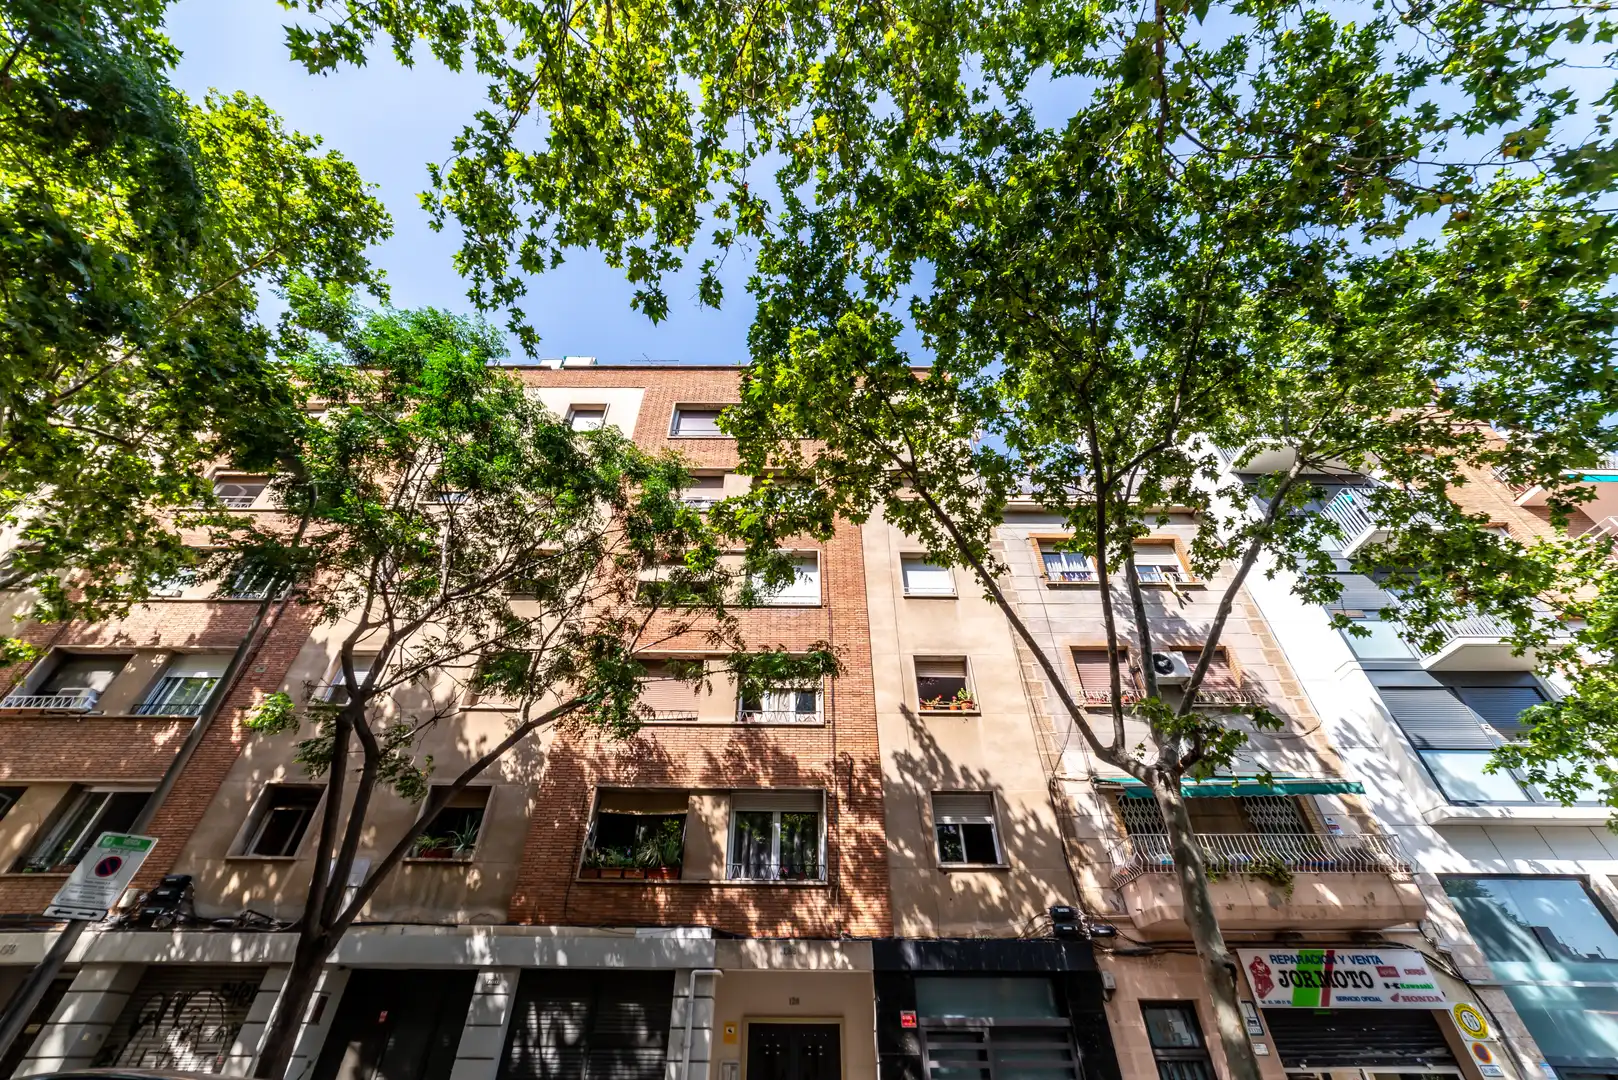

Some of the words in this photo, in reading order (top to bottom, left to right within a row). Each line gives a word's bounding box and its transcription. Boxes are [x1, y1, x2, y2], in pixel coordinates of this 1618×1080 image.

[1338, 955, 1346, 965] Y
[1347, 954, 1384, 965] VENTA
[1278, 969, 1374, 989] JORMOTO
[1401, 995, 1444, 1003] HONDA
